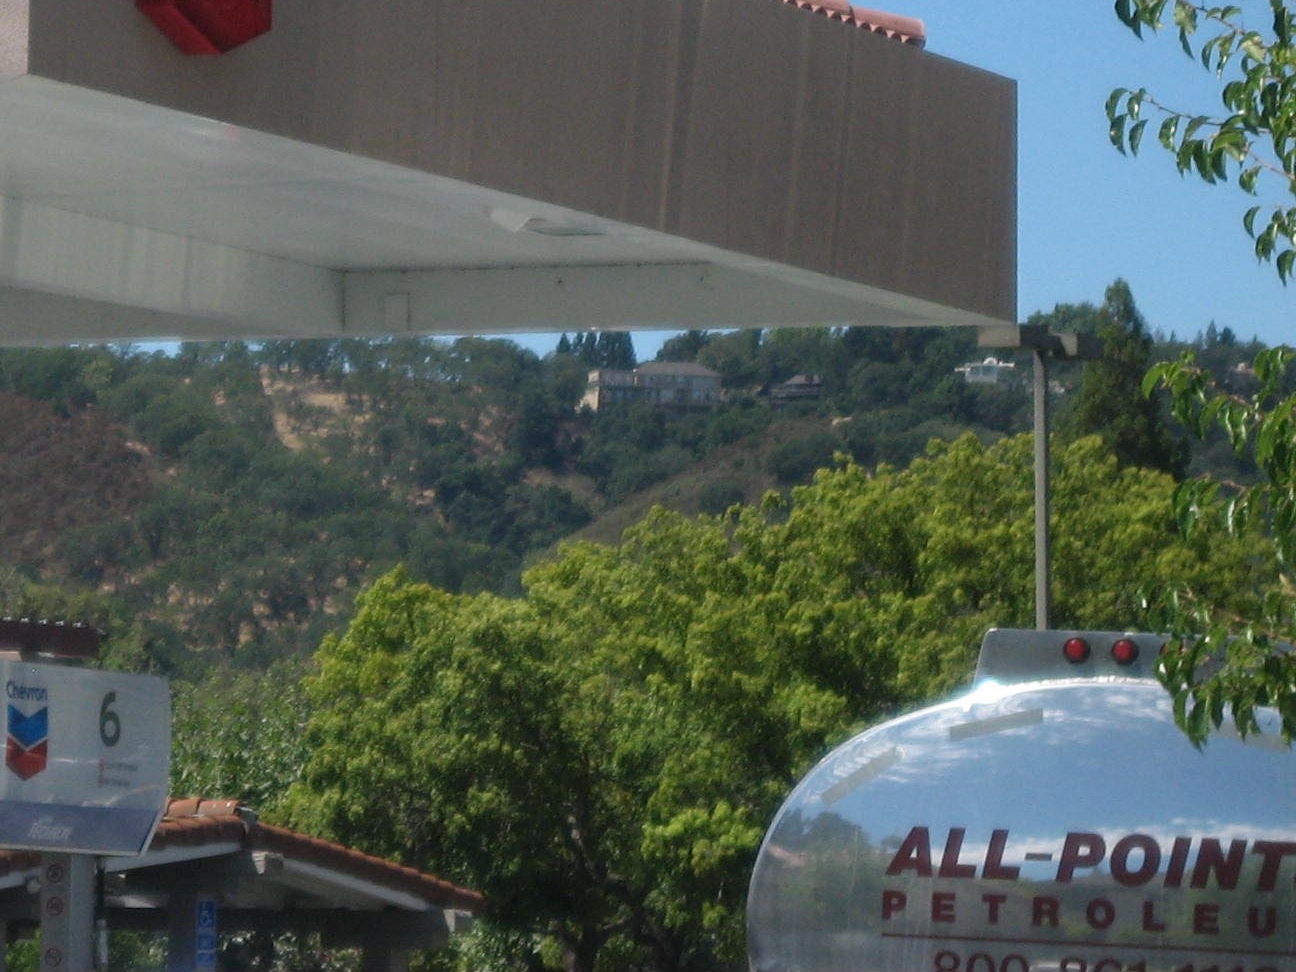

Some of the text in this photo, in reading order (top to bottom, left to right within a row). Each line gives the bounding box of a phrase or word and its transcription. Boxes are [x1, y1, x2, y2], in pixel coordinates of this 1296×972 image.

[6, 680, 48, 701] Chevron
[99, 691, 121, 747] 6
[882, 890, 1277, 939] PETROLEU
